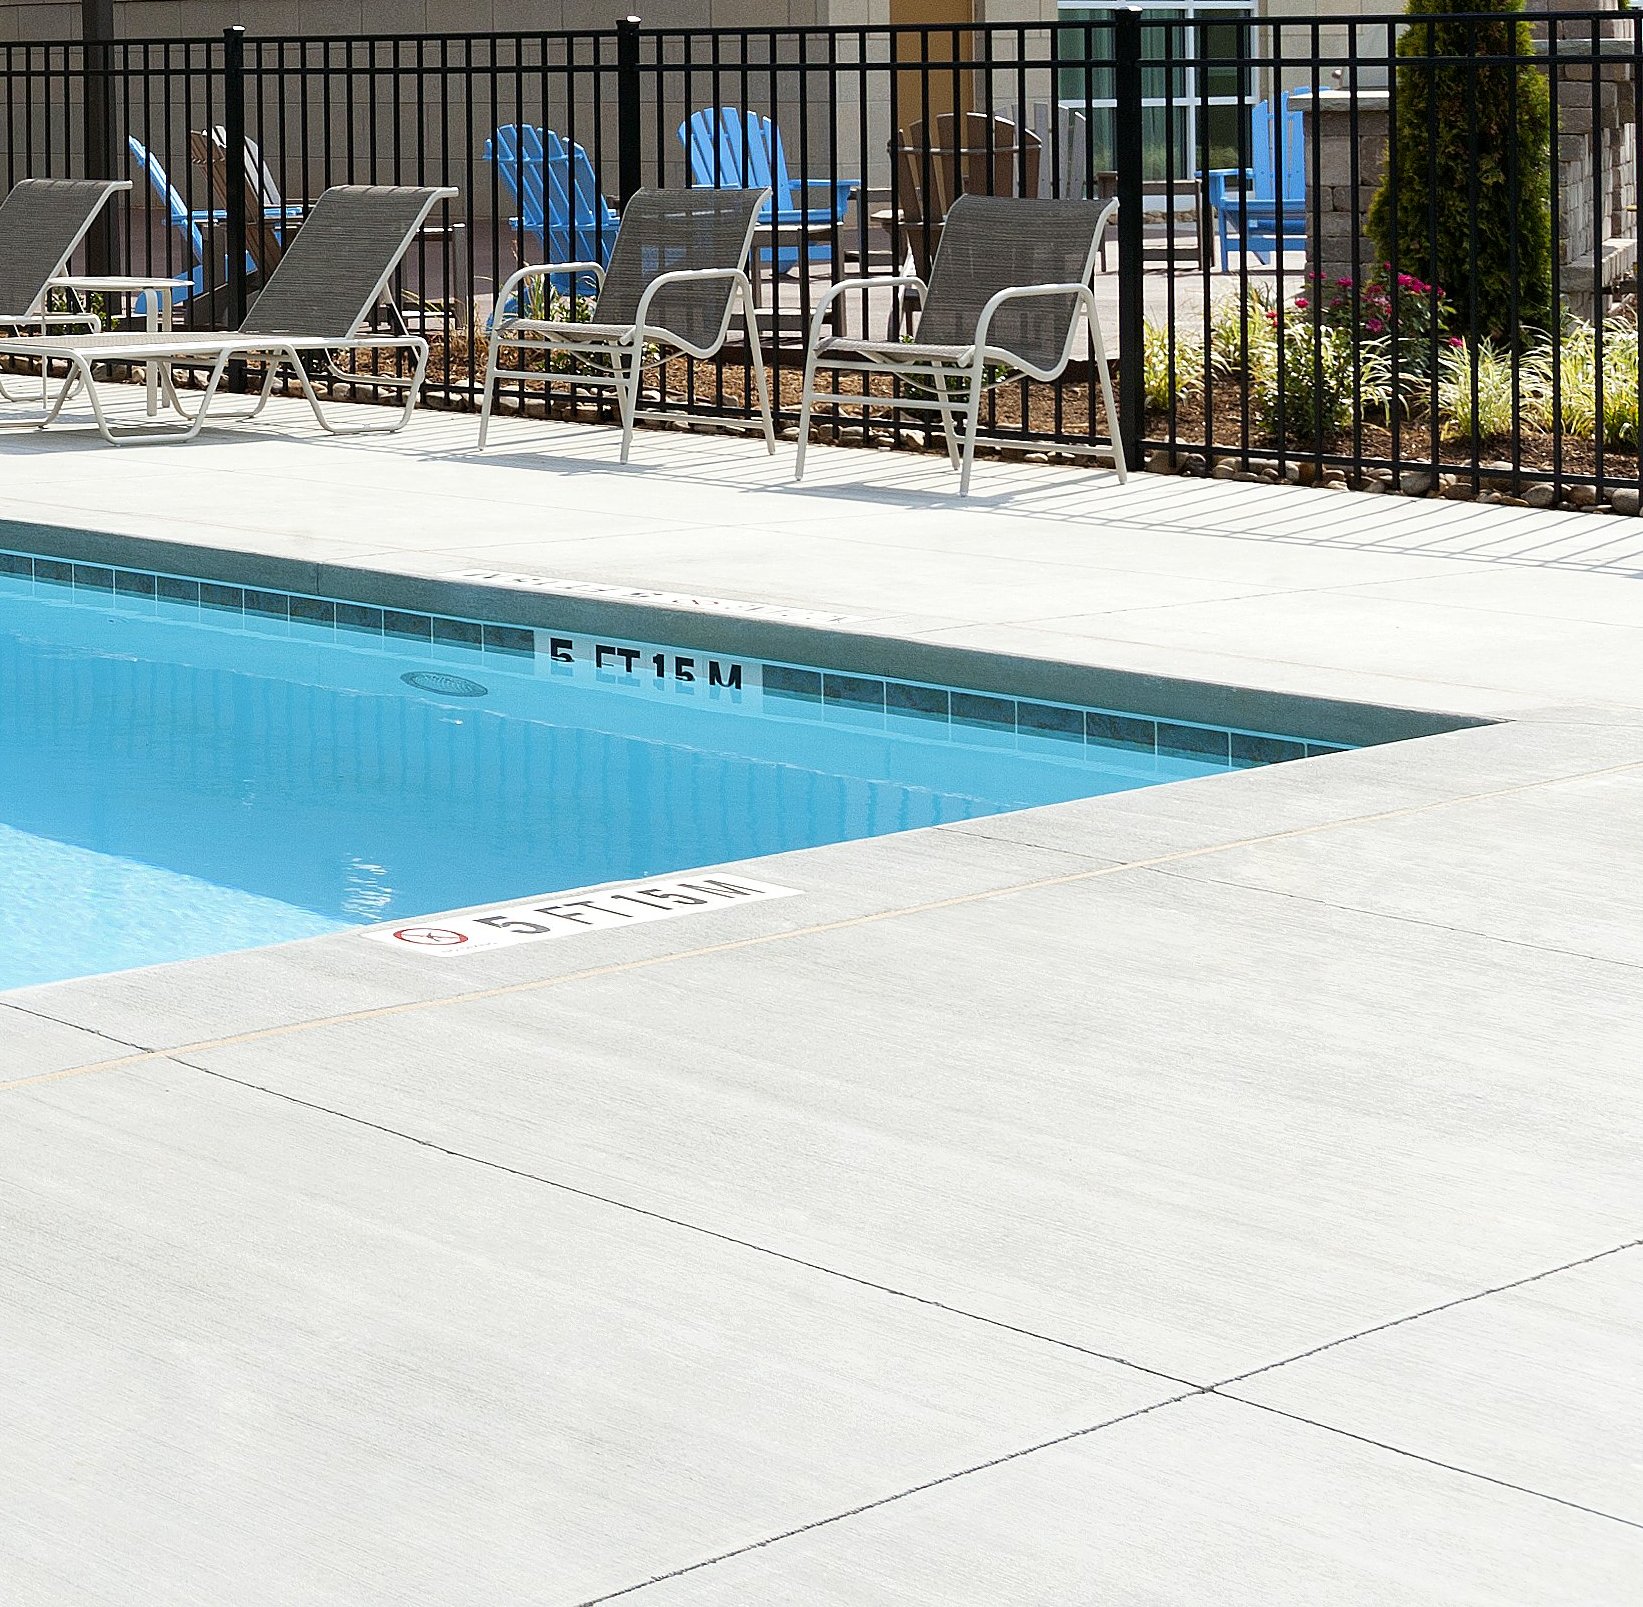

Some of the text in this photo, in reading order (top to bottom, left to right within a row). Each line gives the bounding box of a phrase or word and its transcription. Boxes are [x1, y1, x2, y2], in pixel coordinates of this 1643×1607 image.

[550, 637, 575, 663] 5
[472, 915, 551, 934] 5
[534, 900, 634, 926] FT
